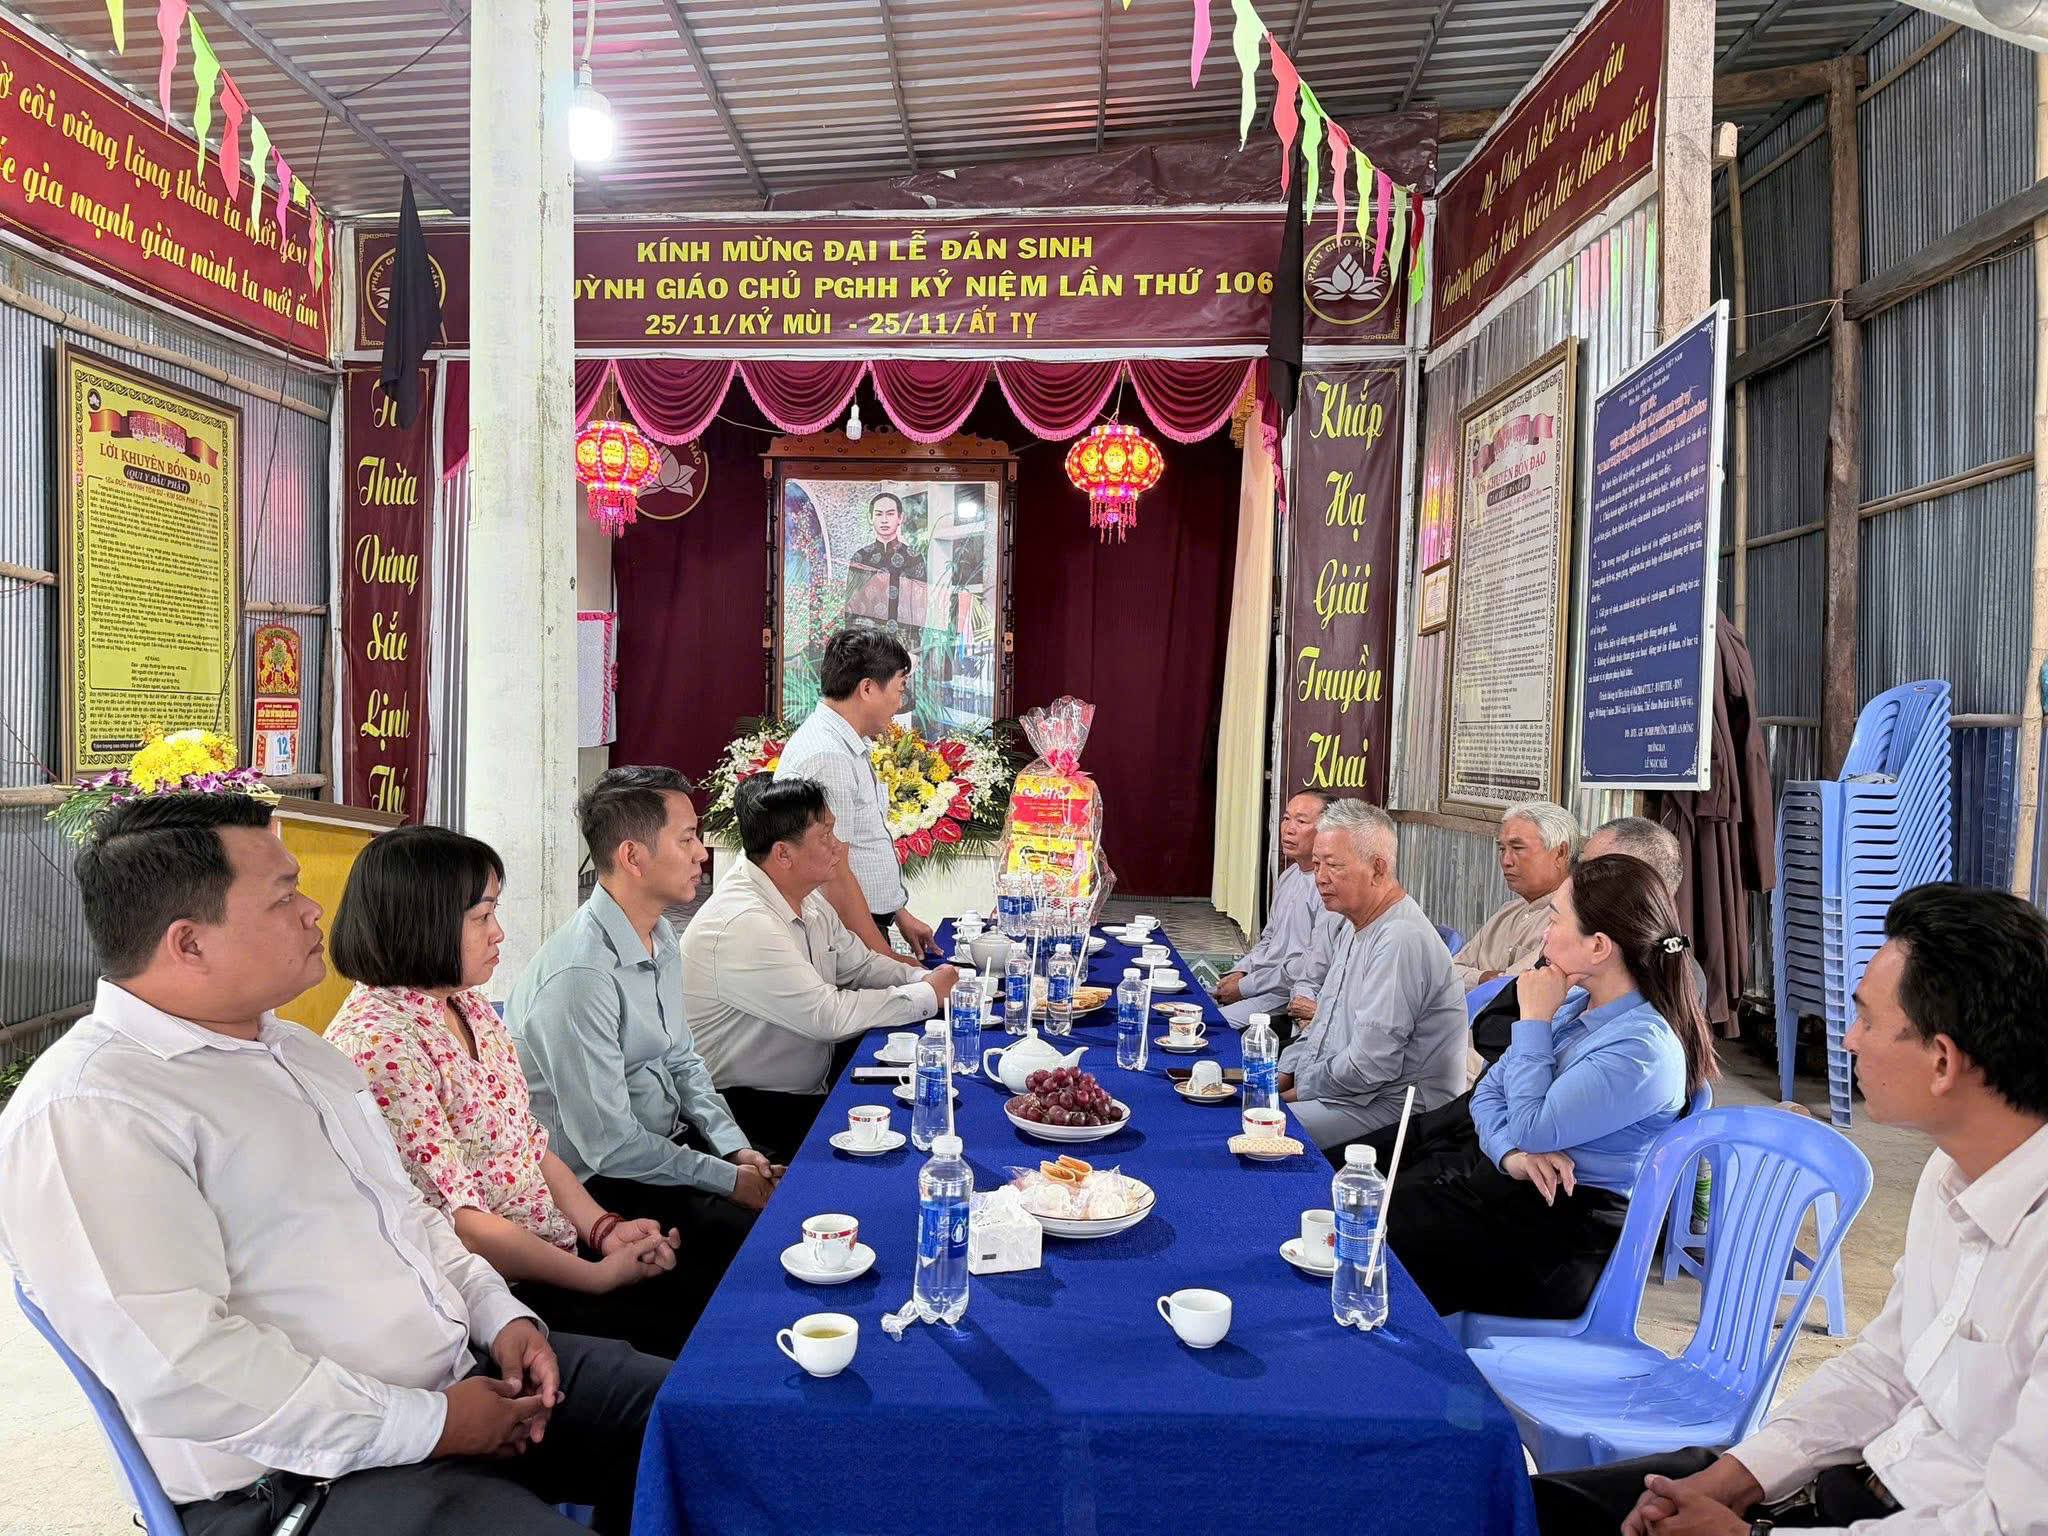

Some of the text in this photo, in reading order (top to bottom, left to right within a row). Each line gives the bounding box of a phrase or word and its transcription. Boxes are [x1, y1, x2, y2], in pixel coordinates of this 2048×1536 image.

[1500, 146, 1523, 194] Cha
[1524, 125, 1539, 169] là
[1541, 99, 1558, 153] kẻ
[1560, 69, 1600, 133] trọng
[1603, 41, 1625, 88] ân
[62, 110, 119, 170] vững
[124, 134, 172, 199] lặng
[176, 169, 219, 220] thân
[223, 197, 242, 232] ta
[1523, 180, 1552, 239] hiếu
[1554, 162, 1575, 211] lúc
[1578, 129, 1614, 188] thân
[1618, 86, 1650, 163] yếu
[22, 162, 65, 208] gia
[70, 191, 136, 240] mạnh
[141, 222, 187, 268] giàu
[191, 249, 238, 293] mình
[242, 269, 260, 302] ta
[263, 286, 292, 318] mới
[295, 293, 320, 330] ấm
[637, 230, 1093, 267] KÍNH MỪNG ĐẠI LỄ ĐẢN SINH
[657, 272, 728, 300] GIÁO
[739, 269, 799, 300] CHỦ
[815, 274, 897, 299] PGHH
[910, 267, 954, 298] KỶ
[966, 271, 1048, 302] NIỆM
[1060, 264, 1124, 297] LẦN
[1133, 266, 1204, 295] THỨ
[1215, 271, 1274, 294] 106
[645, 306, 773, 336] 25/11/KỶ
[783, 306, 832, 334] MÙI
[868, 303, 997, 336] 25/11/ẤT
[1010, 310, 1038, 339] TỴ
[100, 440, 118, 459] LỜI
[121, 449, 165, 472] KHUYÊN
[190, 468, 211, 486] ĐẠO
[357, 455, 418, 506] Thừa
[1297, 379, 1385, 788] Khắp Hạ Giái Truyền Khai
[367, 611, 408, 661] Sắc
[360, 688, 411, 752] Lịnh
[277, 736, 288, 756] 12
